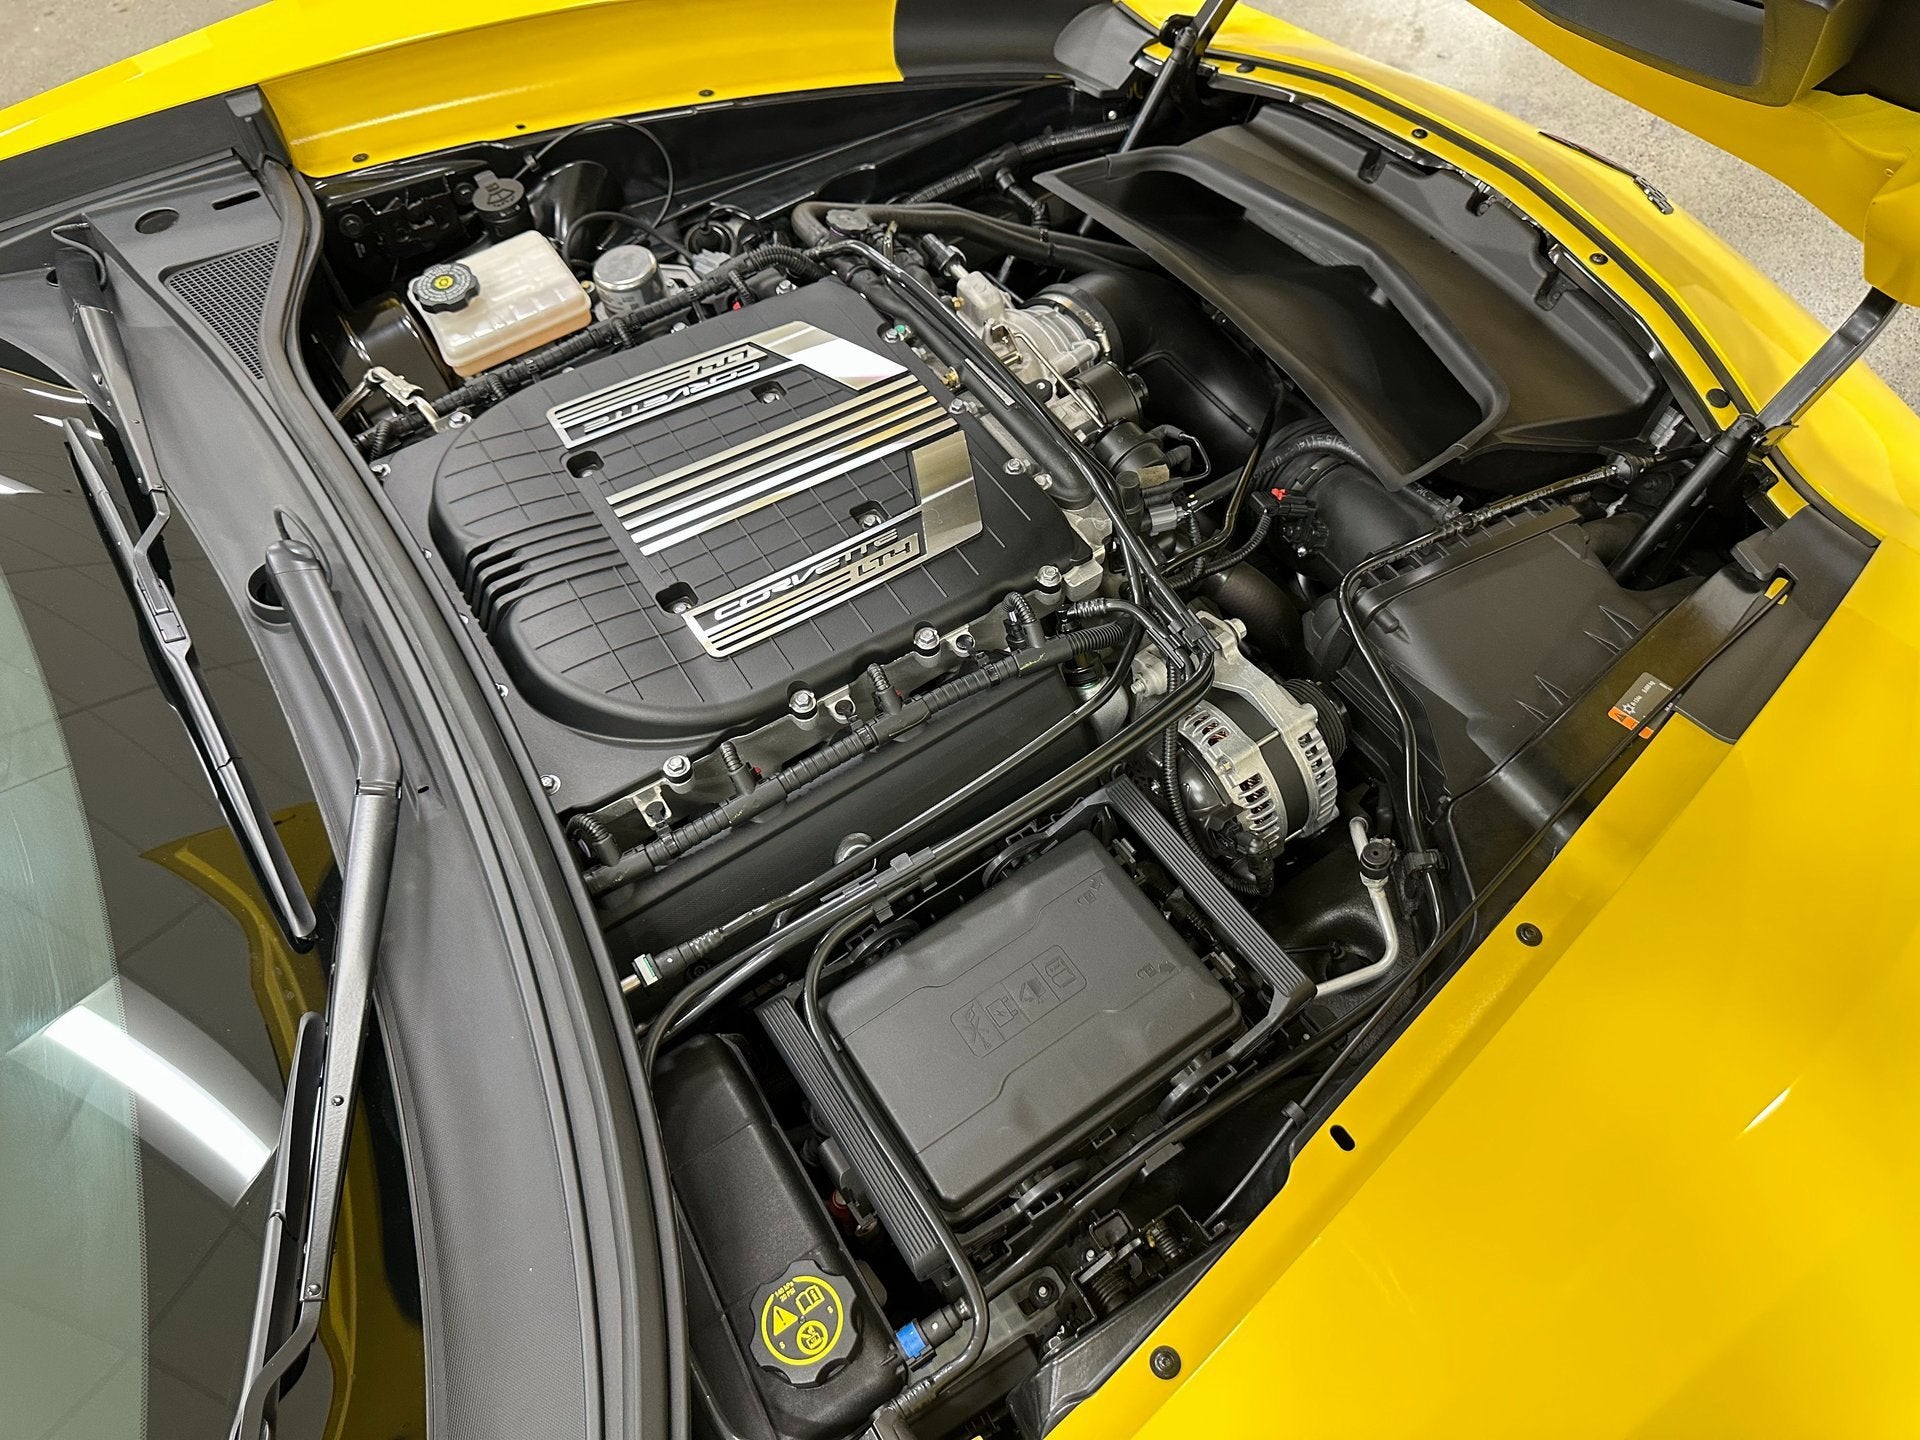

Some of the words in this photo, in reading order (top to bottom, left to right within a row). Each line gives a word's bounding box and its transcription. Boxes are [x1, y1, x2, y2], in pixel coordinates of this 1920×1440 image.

[697, 349, 749, 375] LT4
[583, 361, 760, 434] CORVETTE
[714, 528, 898, 622] CORVETTE
[857, 541, 912, 577] LT4
